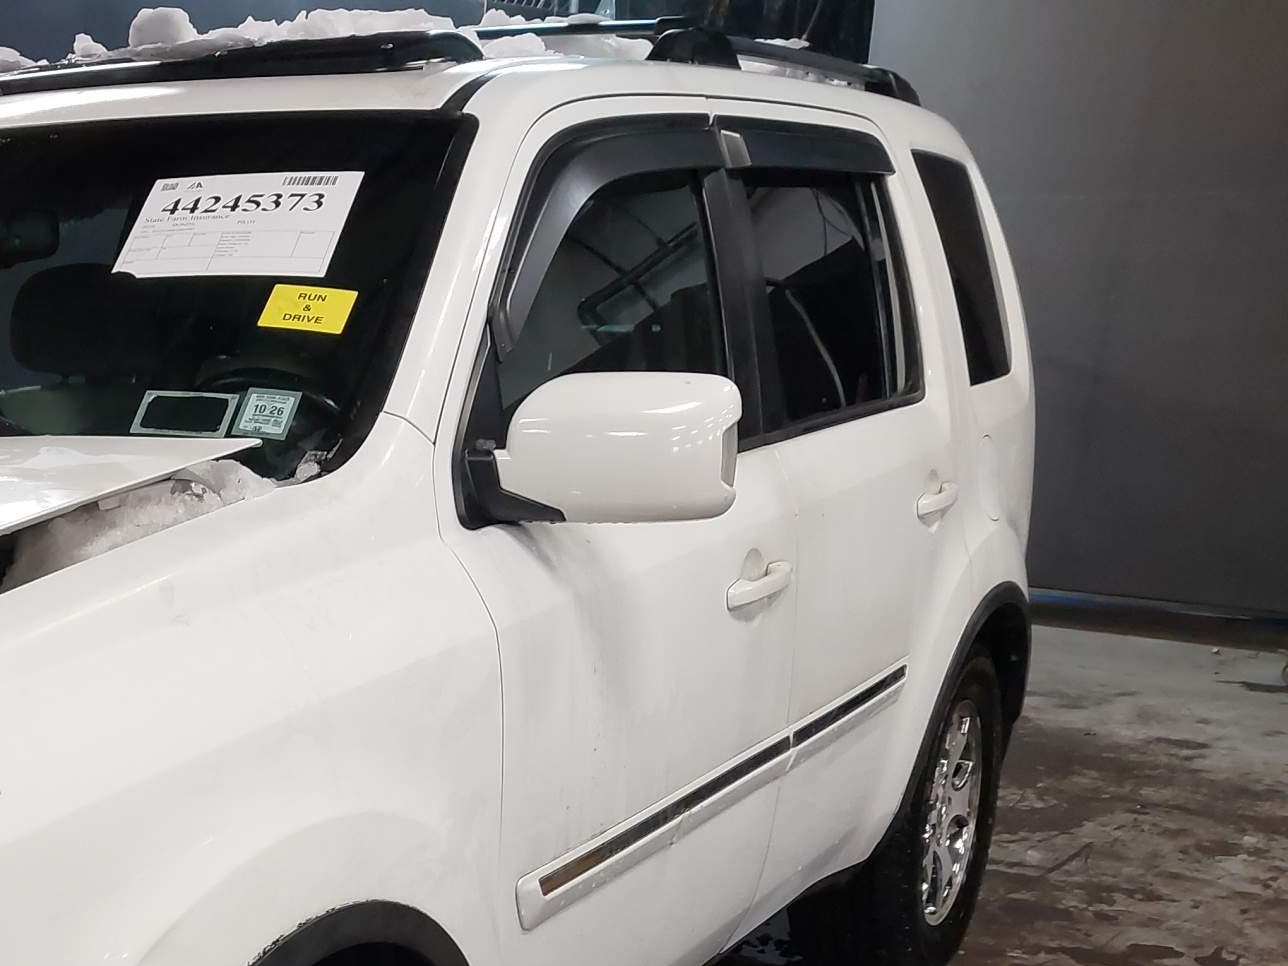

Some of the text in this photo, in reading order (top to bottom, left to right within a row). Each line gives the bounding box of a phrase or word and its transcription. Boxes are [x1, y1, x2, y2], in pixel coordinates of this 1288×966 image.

[162, 192, 326, 216] 44245373
[297, 292, 328, 302] RUN
[302, 304, 312, 312] &
[282, 313, 325, 325] DRIVE
[253, 403, 285, 416] 10 26
